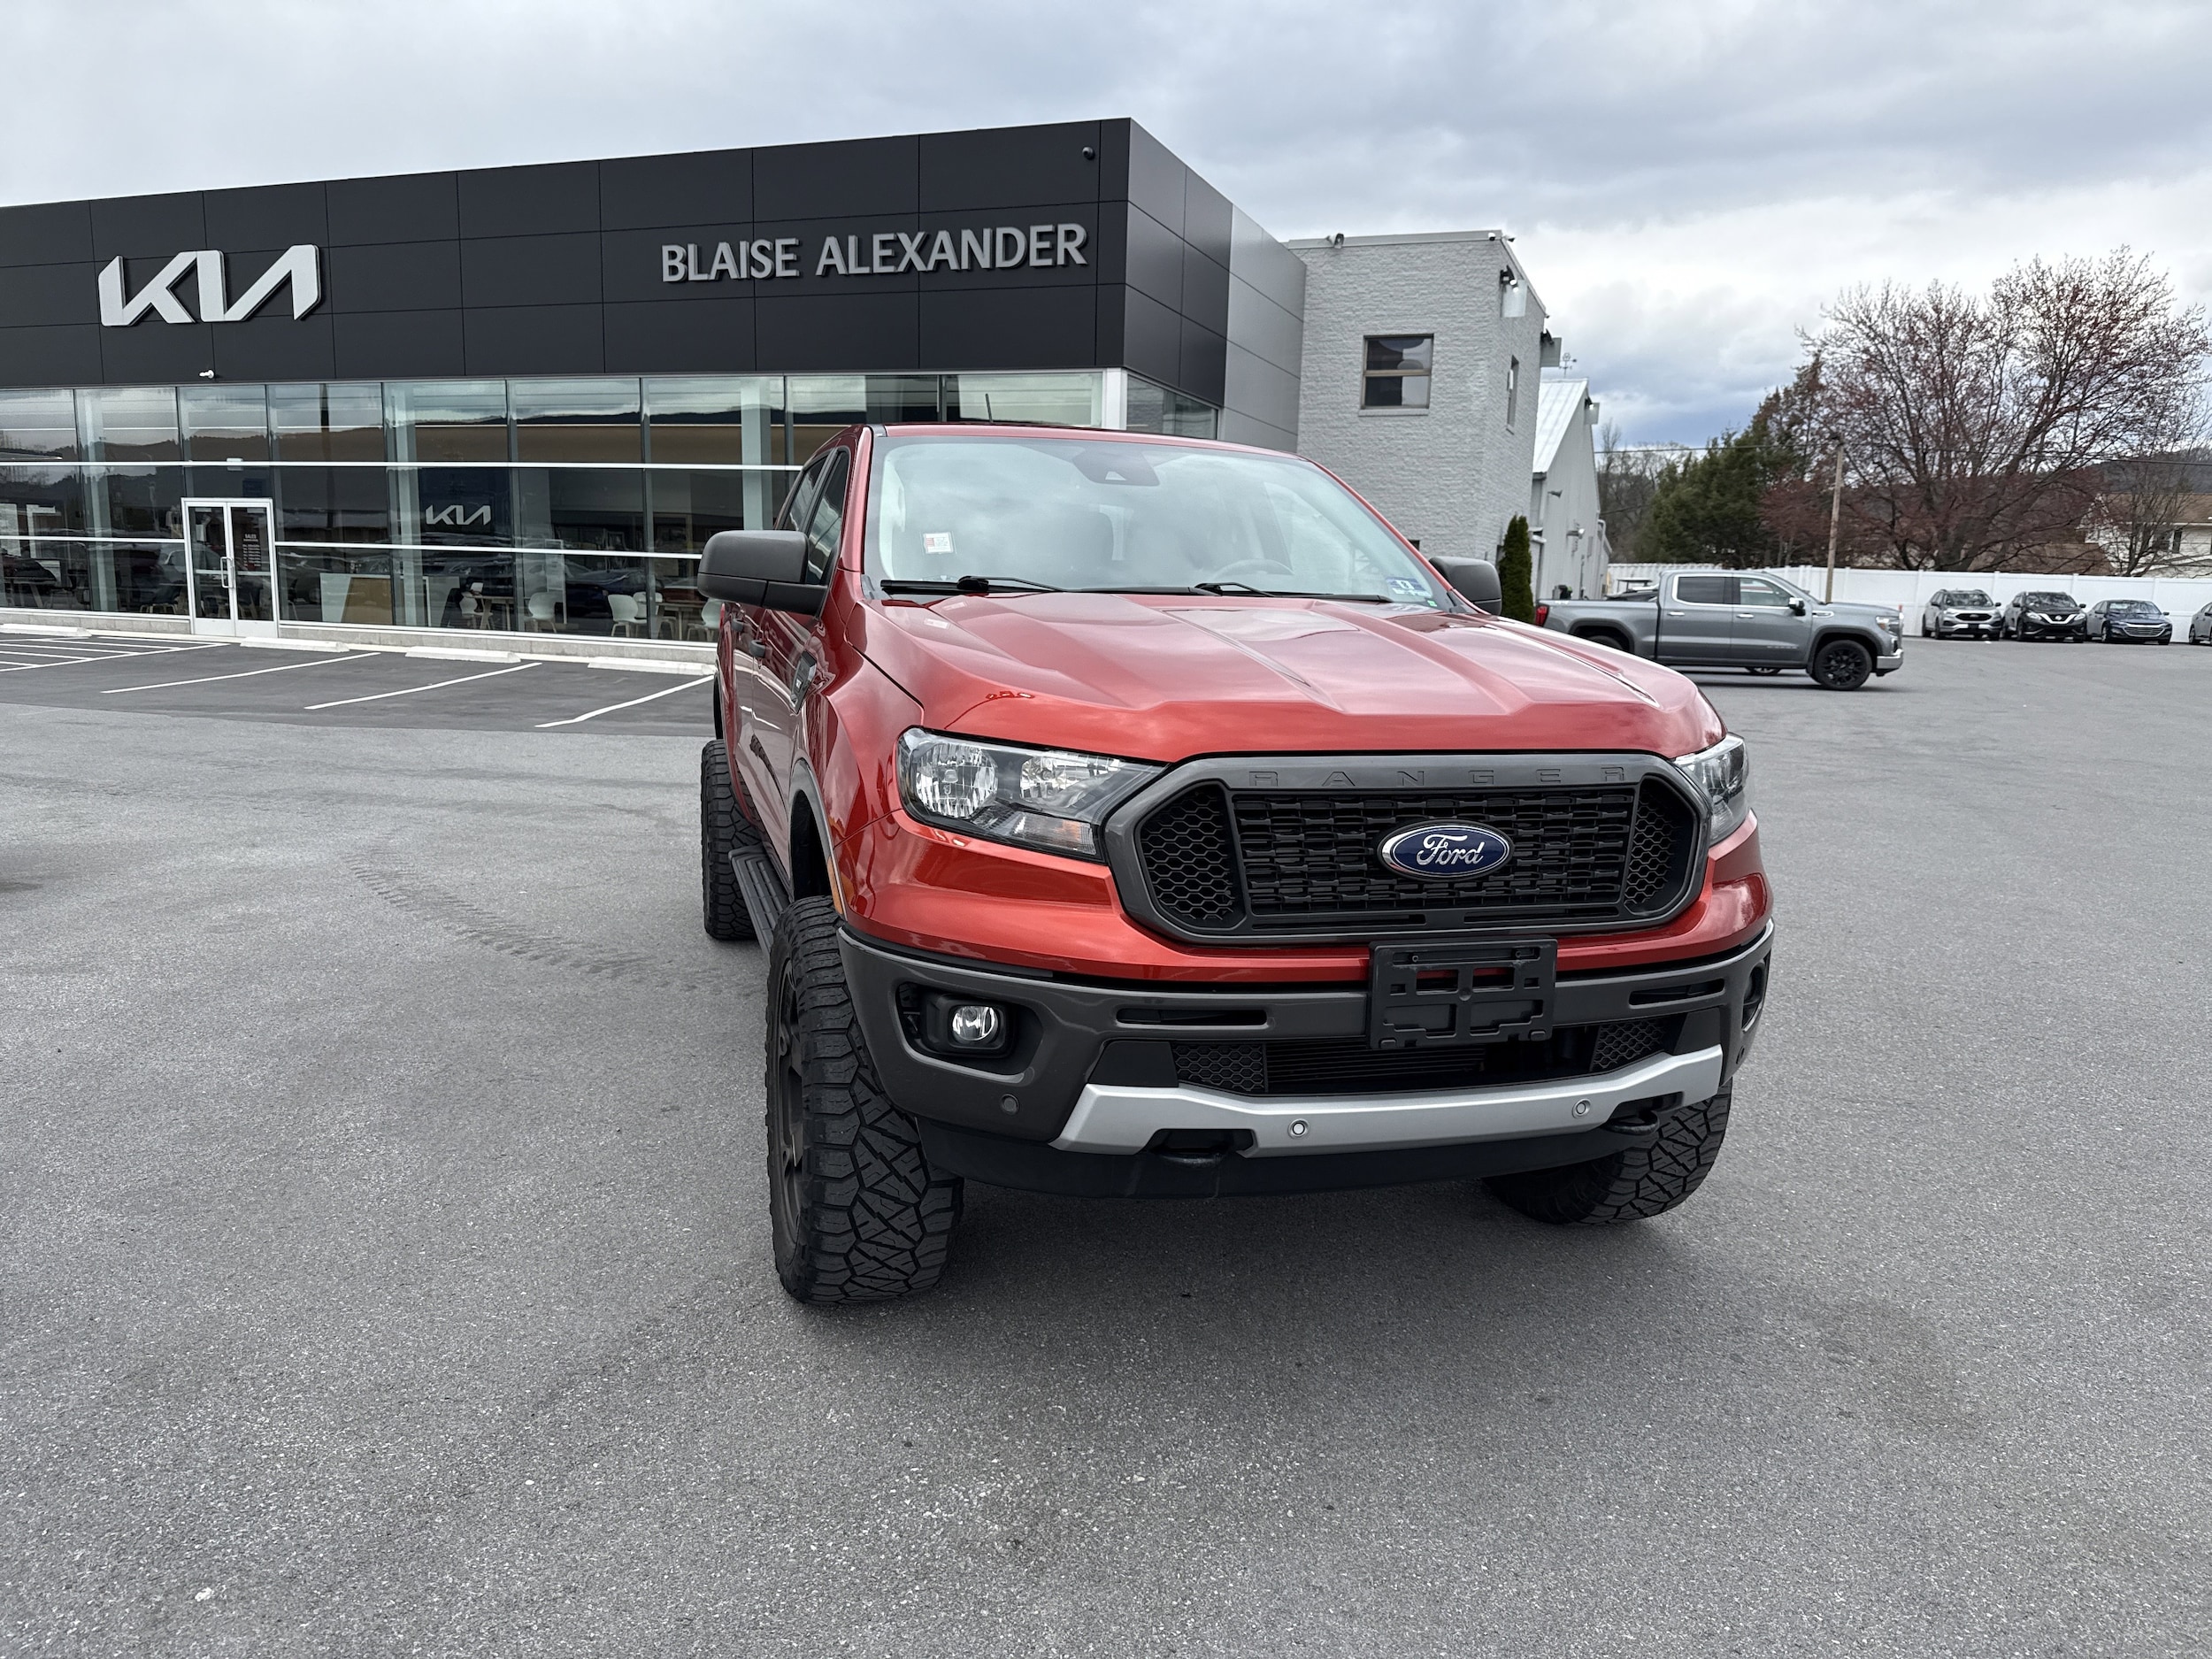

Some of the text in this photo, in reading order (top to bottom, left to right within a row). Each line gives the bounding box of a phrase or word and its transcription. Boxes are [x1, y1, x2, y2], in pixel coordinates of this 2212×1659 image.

[661, 223, 1089, 282] BLAISE ALEXANDER
[97, 243, 322, 327] KIA
[425, 503, 492, 526] KIA
[1248, 765, 1626, 787] RANGER
[1416, 833, 1486, 866] Ford
